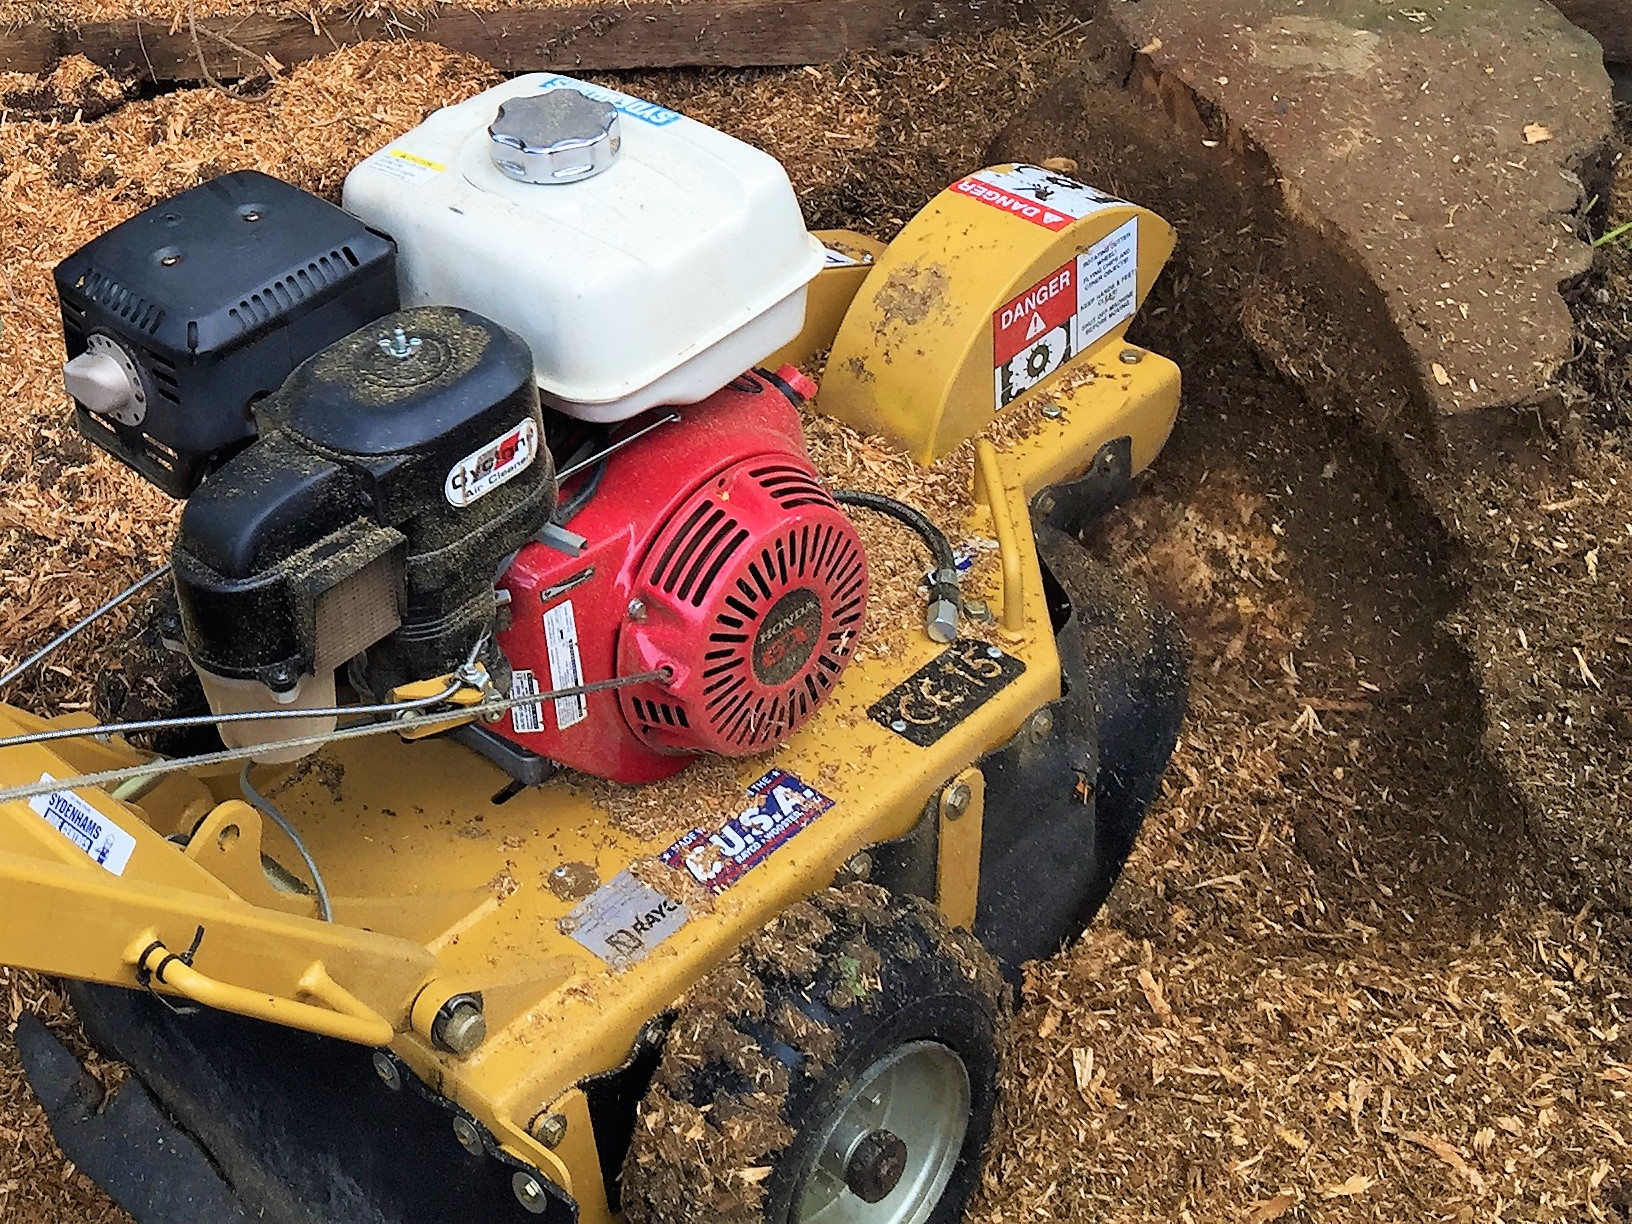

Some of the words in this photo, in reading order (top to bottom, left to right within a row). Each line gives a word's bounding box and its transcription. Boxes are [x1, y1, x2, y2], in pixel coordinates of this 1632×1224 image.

[958, 180, 1041, 217] DANGER
[1001, 269, 1070, 331] DANGER
[466, 485, 483, 498] Air
[489, 455, 532, 485] Cleane
[759, 600, 817, 644] HONDA
[48, 792, 102, 840] SYDENHAMS
[670, 829, 698, 854] MADE
[751, 775, 772, 793] THE
[734, 842, 762, 864] RAYCO
